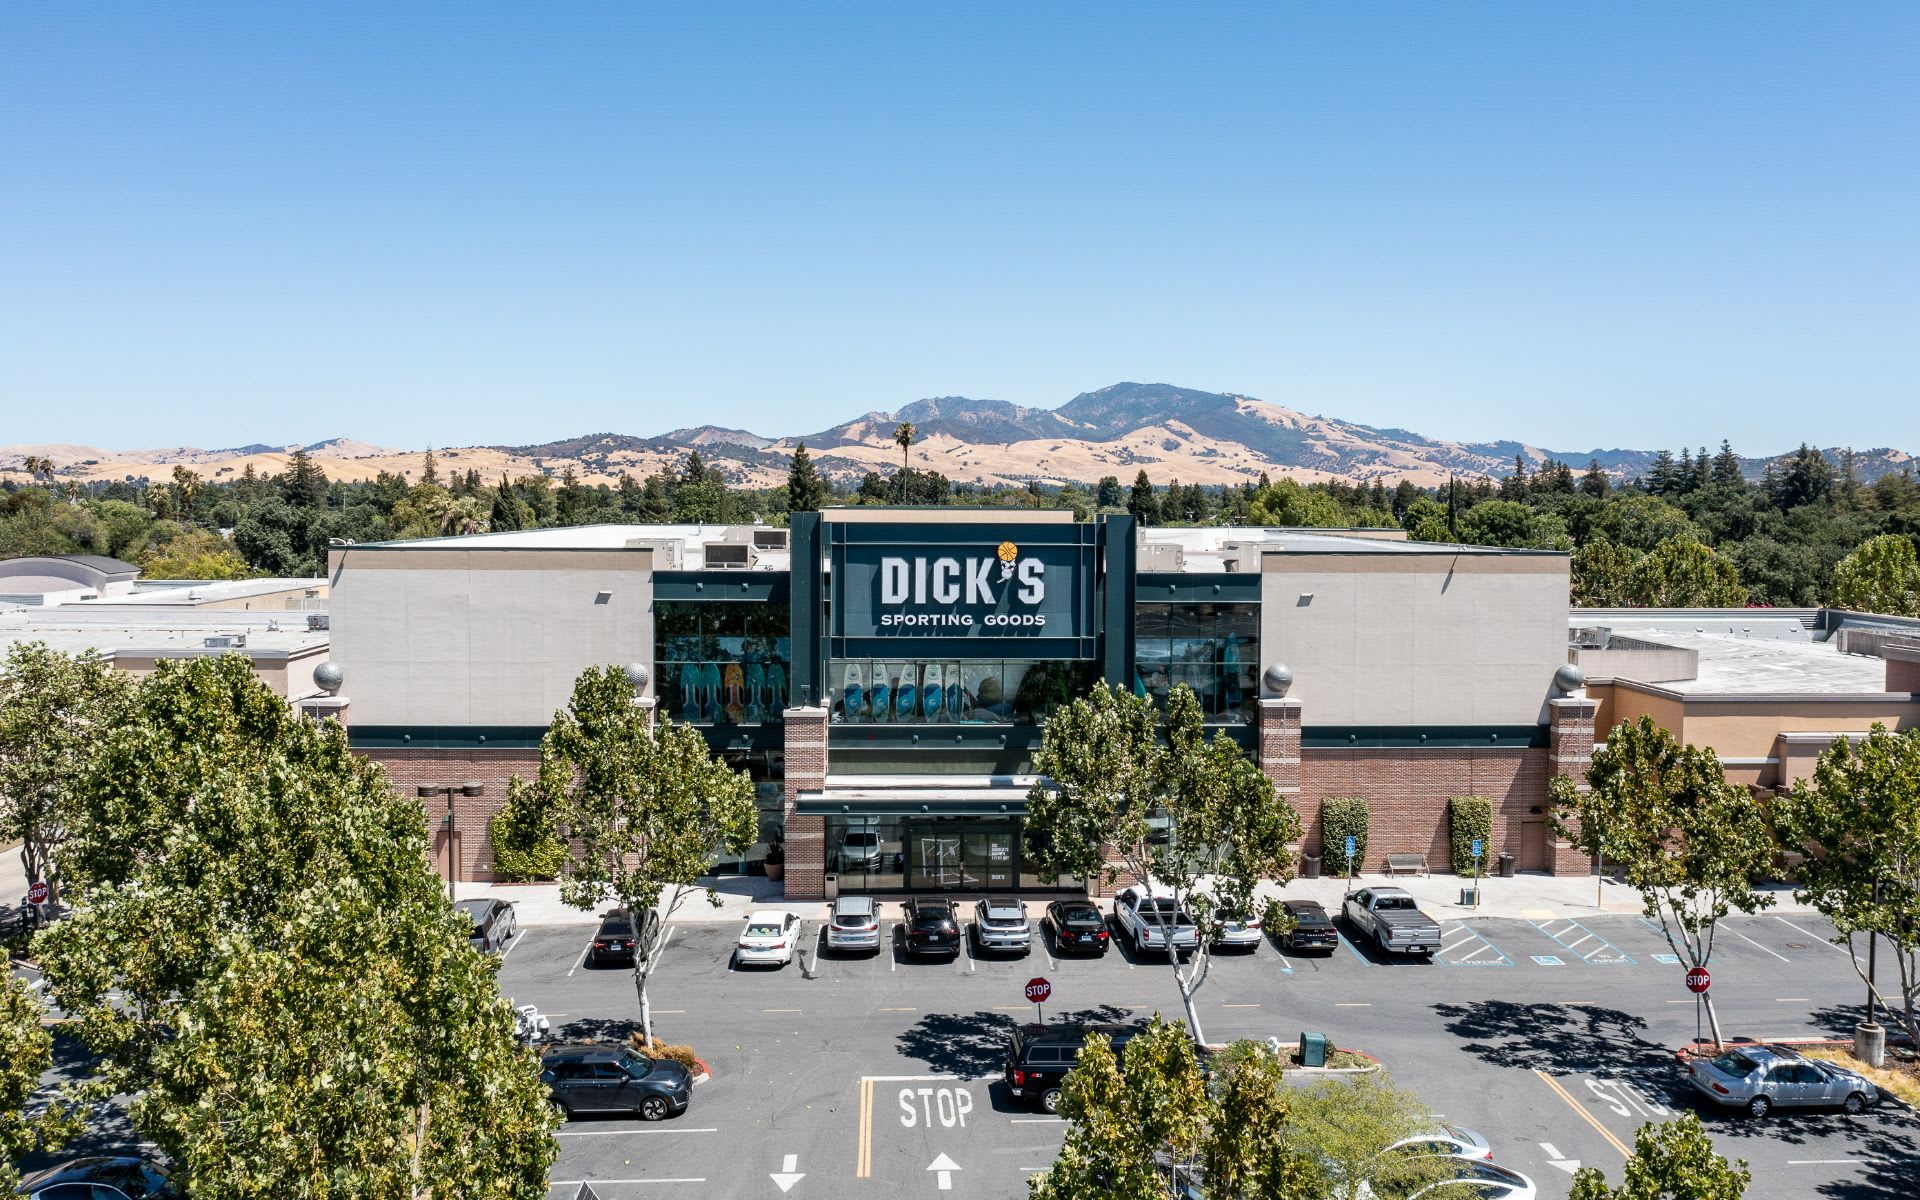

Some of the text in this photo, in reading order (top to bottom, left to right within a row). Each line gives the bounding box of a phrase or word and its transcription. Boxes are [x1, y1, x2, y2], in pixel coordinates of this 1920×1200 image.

[881, 541, 1045, 604] DICK'S
[881, 614, 1046, 626] SPORTING GOODS
[29, 887, 47, 900] STOP
[1687, 975, 1710, 986] STOP
[1026, 983, 1050, 997] STOP
[899, 1087, 974, 1128] STOP
